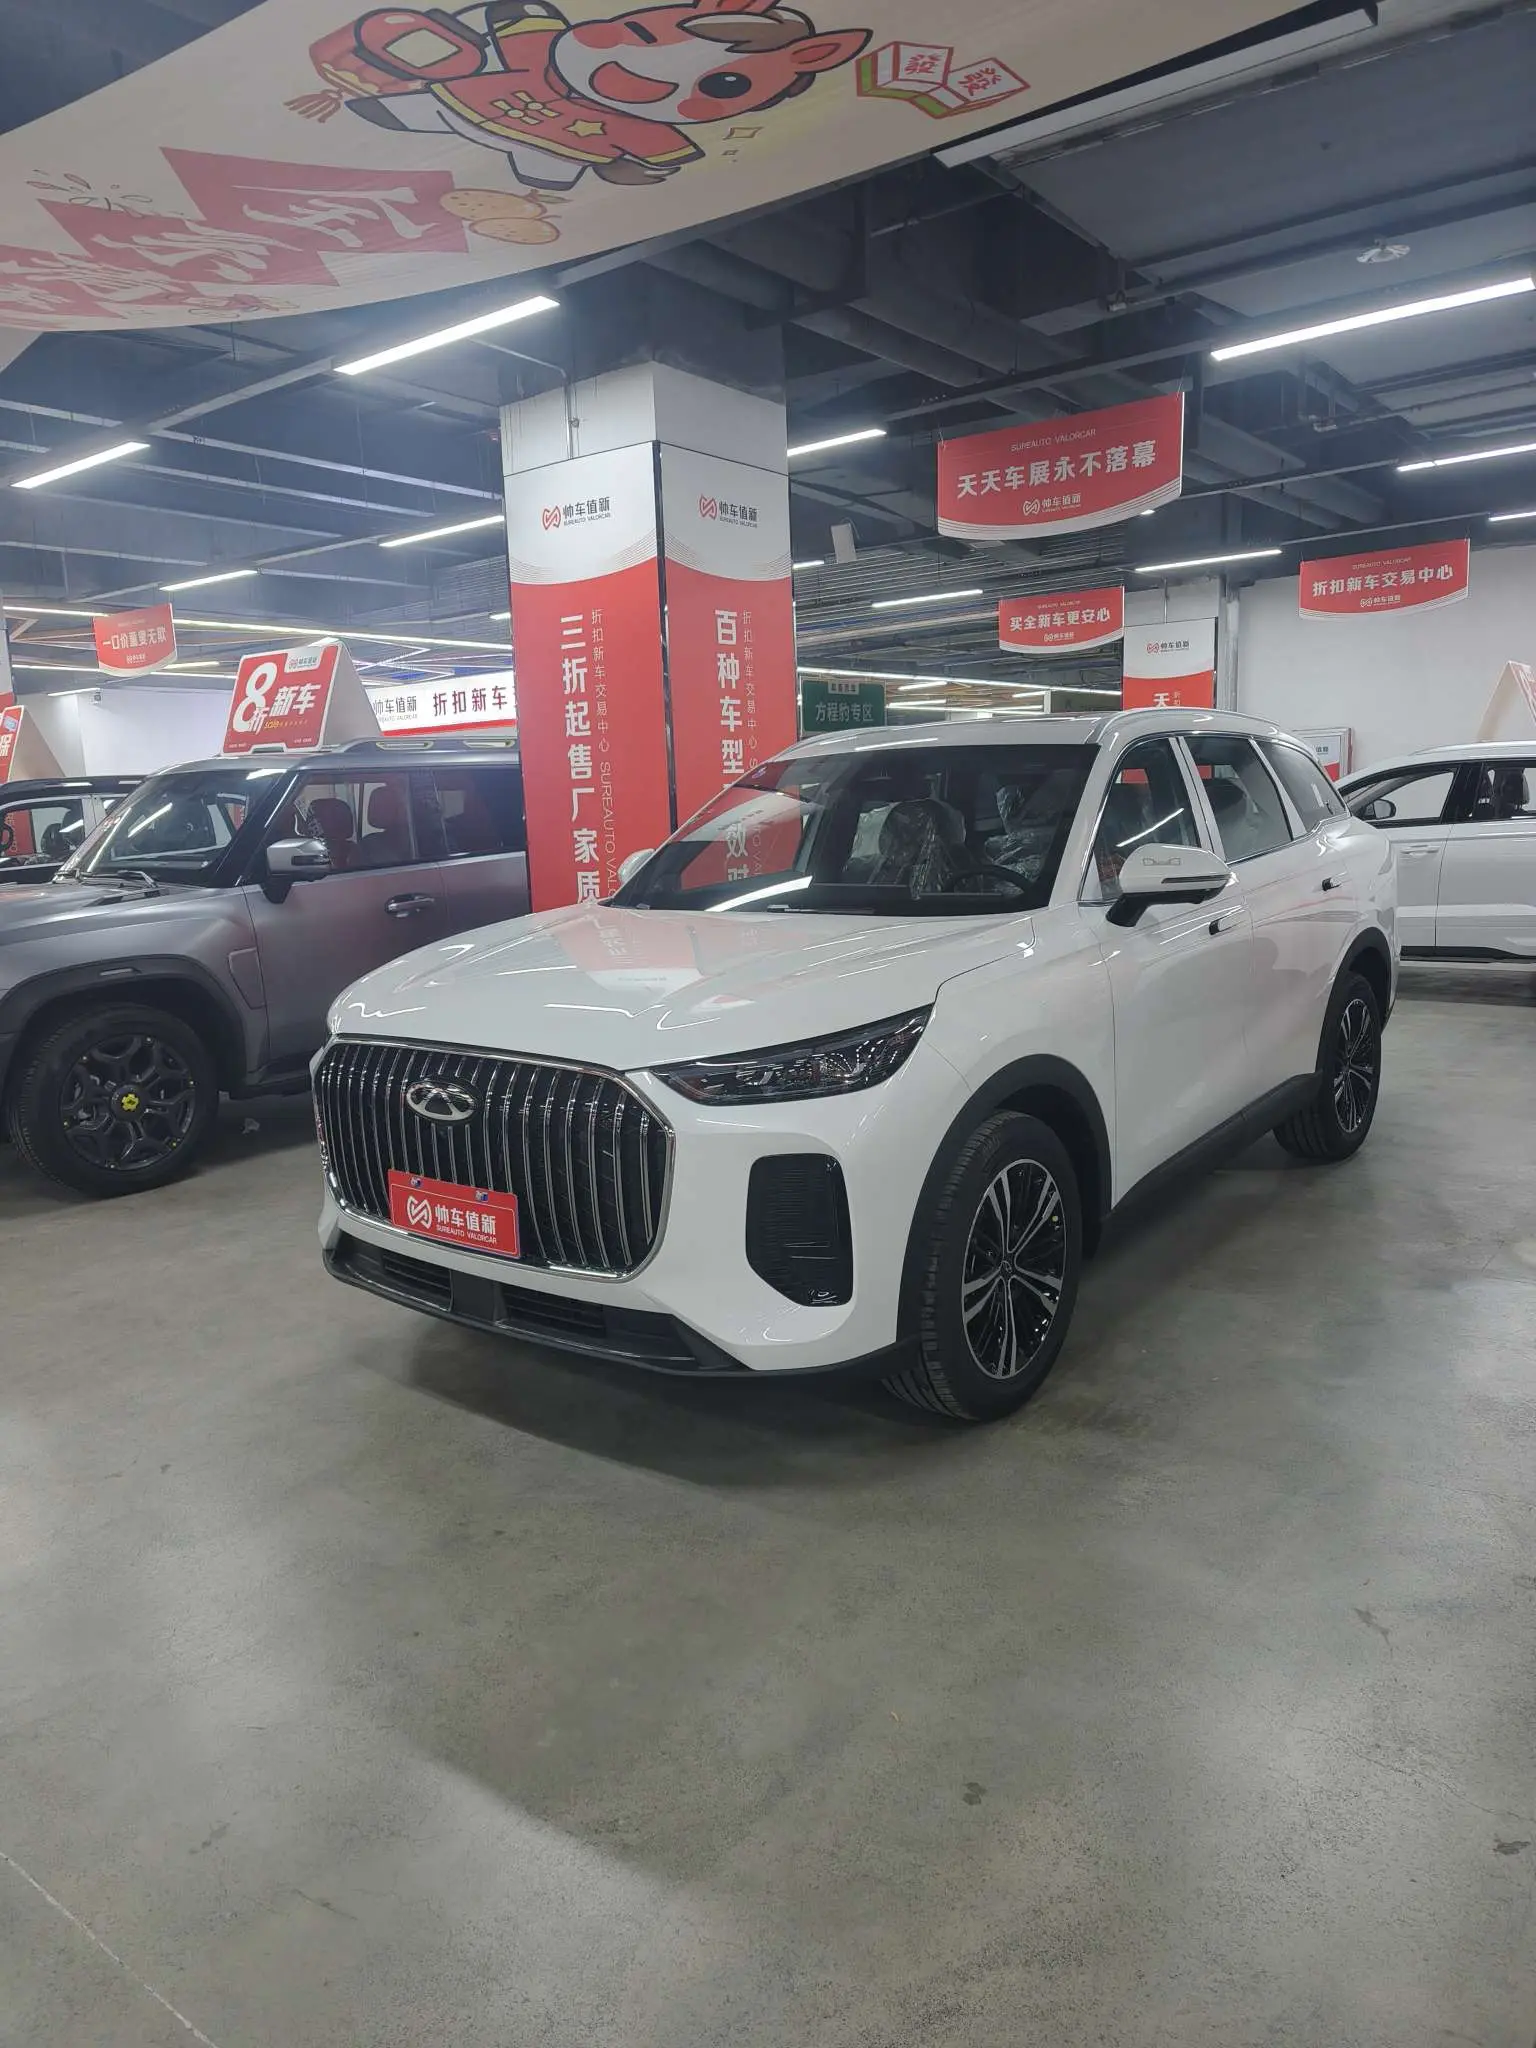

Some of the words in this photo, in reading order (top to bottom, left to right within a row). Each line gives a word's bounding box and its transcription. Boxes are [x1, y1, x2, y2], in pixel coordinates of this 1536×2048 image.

[1055, 428, 1097, 444] VALORCAR
[957, 440, 1157, 499] 天天车展永不落幕
[562, 496, 610, 519] 帅车值新
[719, 500, 758, 521] 帅车值新
[1312, 563, 1454, 597] 折扣新车交易中心
[1010, 606, 1111, 632] 买全新车更安心
[102, 624, 167, 650] 一口价童叟无欺
[591, 608, 610, 752] 折扣新车交易中心
[743, 610, 759, 750] 折扣新车交易中心
[269, 683, 322, 717] 新车
[432, 685, 518, 717] 折扣新车
[815, 701, 875, 722] 方程豹专区
[600, 761, 617, 854] SUREAUTO
[434, 1204, 496, 1235] 帅车值新
[436, 1224, 465, 1237] SUREAUTO
[467, 1231, 498, 1245] VALORCAR
